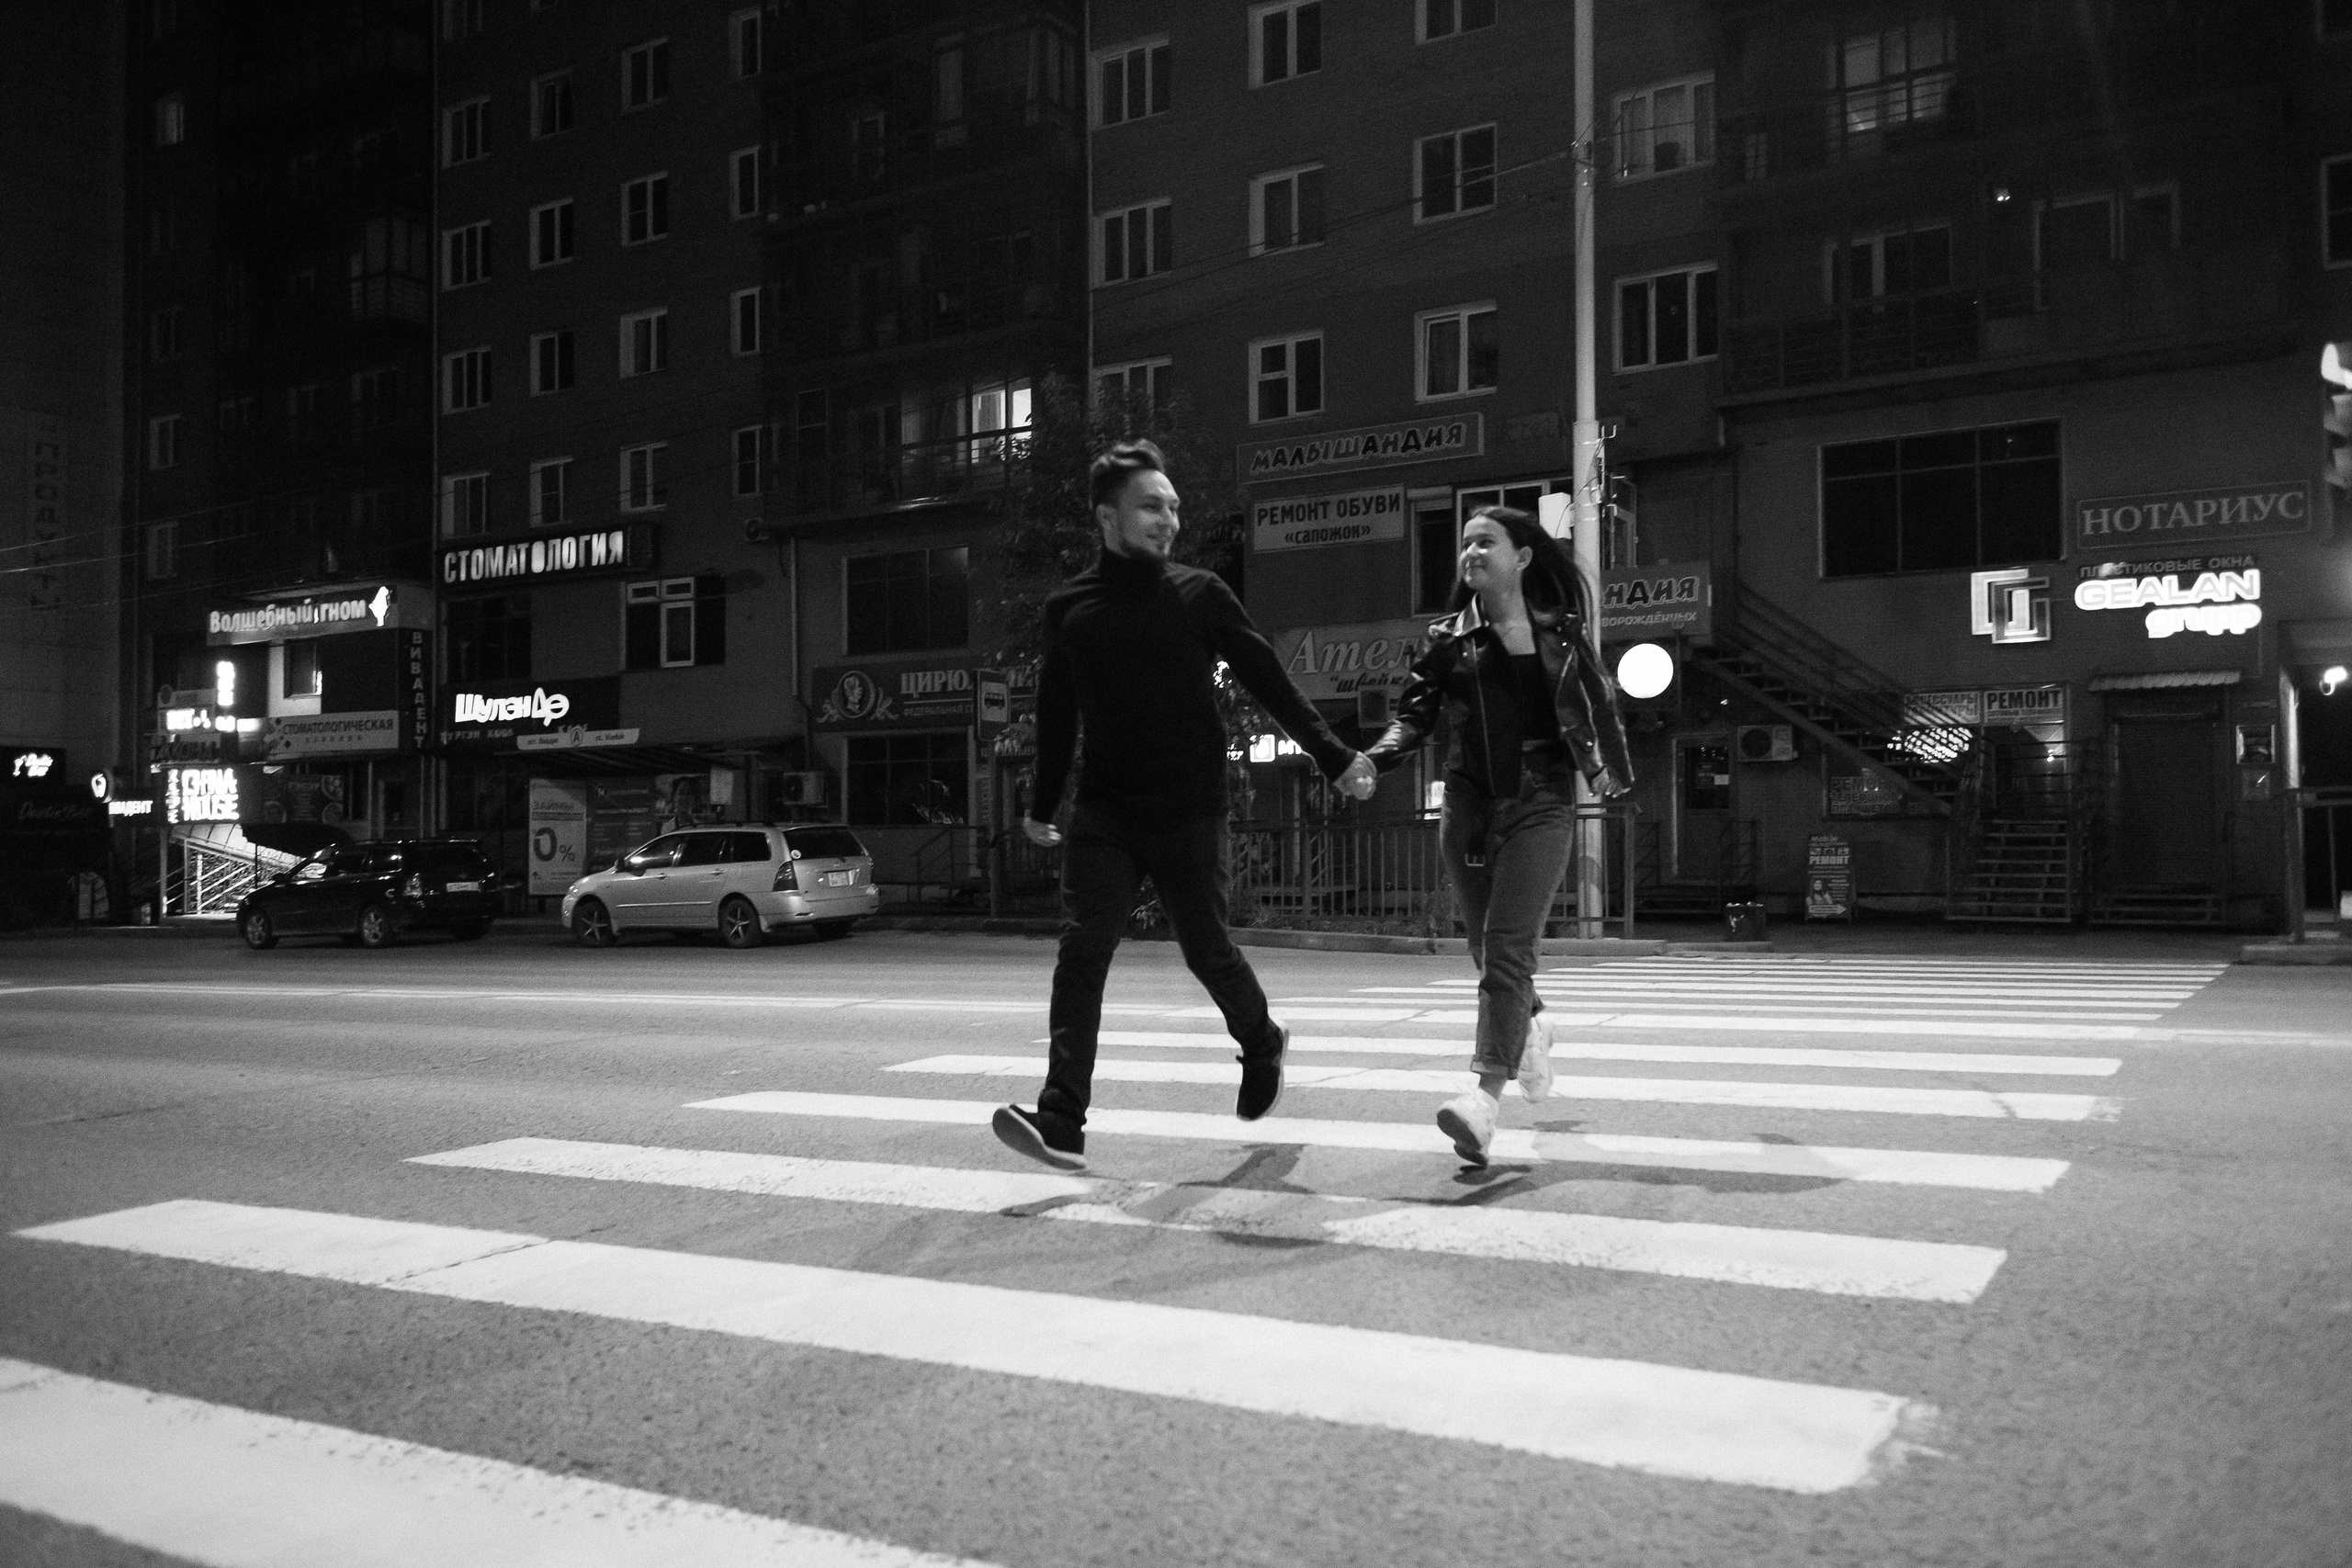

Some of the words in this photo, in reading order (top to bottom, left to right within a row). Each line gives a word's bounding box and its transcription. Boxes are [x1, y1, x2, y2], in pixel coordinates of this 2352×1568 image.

[1250, 422, 1465, 475] МАЛЫШАНДИЯ
[1257, 501, 1330, 526] РЕМОНТ
[1337, 491, 1400, 518] ОБУВИ
[2082, 491, 2304, 536] НОТАРИУС
[444, 530, 624, 584] СТОМАТОЛОГИЯ
[2079, 558, 2202, 579] ПЛСТИКОВЫЕ
[2207, 555, 2256, 570] ОКНА
[2075, 569, 2260, 611] GEALAN
[209, 599, 312, 634] Волшебный
[411, 631, 428, 749] ВИВАДЕНТ
[1986, 690, 2061, 710] РЕМОНТ
[283, 718, 394, 736] СТОМАТОЛОГИЧЕСКАЯ
[182, 793, 240, 822] HOUSE
[1809, 855, 1849, 864] РЕМОНТ
